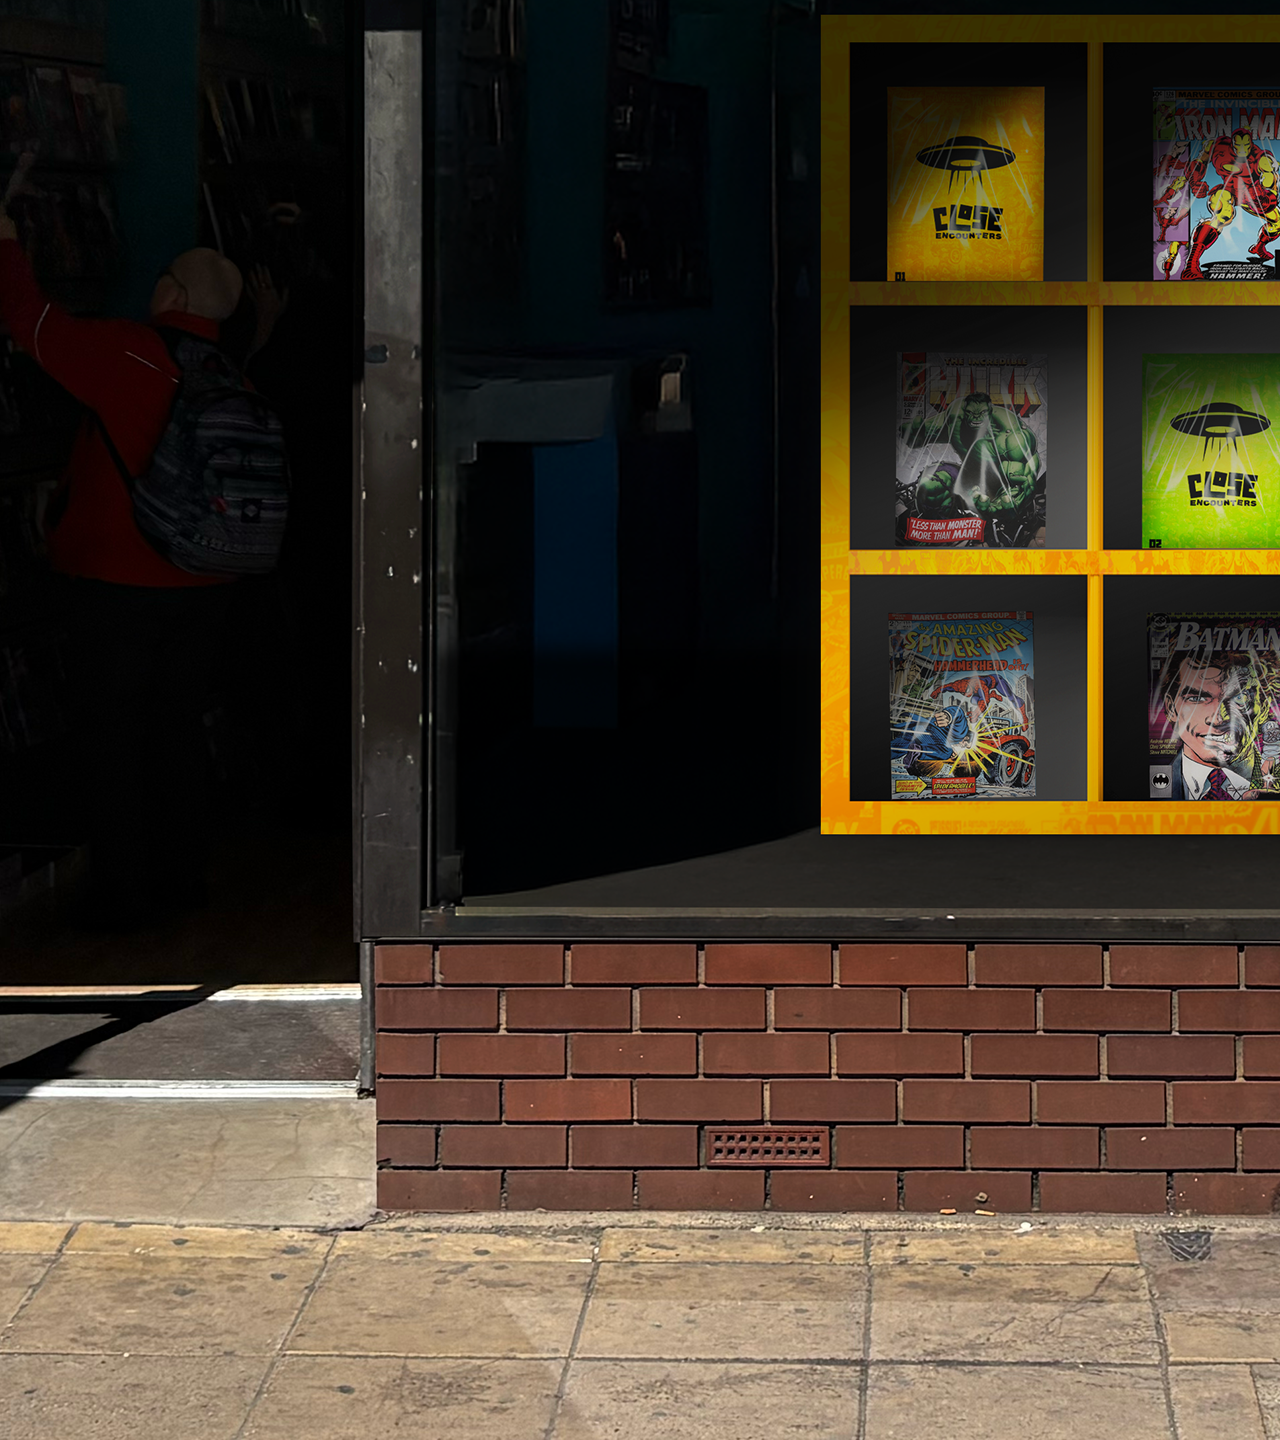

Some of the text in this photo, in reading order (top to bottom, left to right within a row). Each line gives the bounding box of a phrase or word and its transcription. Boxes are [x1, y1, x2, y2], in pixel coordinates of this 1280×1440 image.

[1182, 99, 1206, 108] THE
[1174, 108, 1233, 140] IRON
[932, 204, 1004, 232] CLOSE
[935, 232, 1002, 240] ENCOUNTERS
[945, 357, 1028, 366] THE INCREDIBLE
[929, 365, 1043, 411] HULK
[1187, 471, 1258, 499] CLOSE
[1190, 499, 1257, 507] ENCOUNTERS
[929, 522, 946, 530] THAN
[947, 519, 982, 530] MONSTER
[910, 529, 932, 540] MORE
[933, 531, 951, 540] THAN
[1149, 539, 1162, 549] 02
[911, 613, 945, 621] MARVEL
[946, 612, 979, 620] COMICS
[933, 621, 1004, 636] AMAZING
[903, 628, 1029, 658] SPIDER-MAN
[933, 660, 1008, 672] HAMMERHEAD
